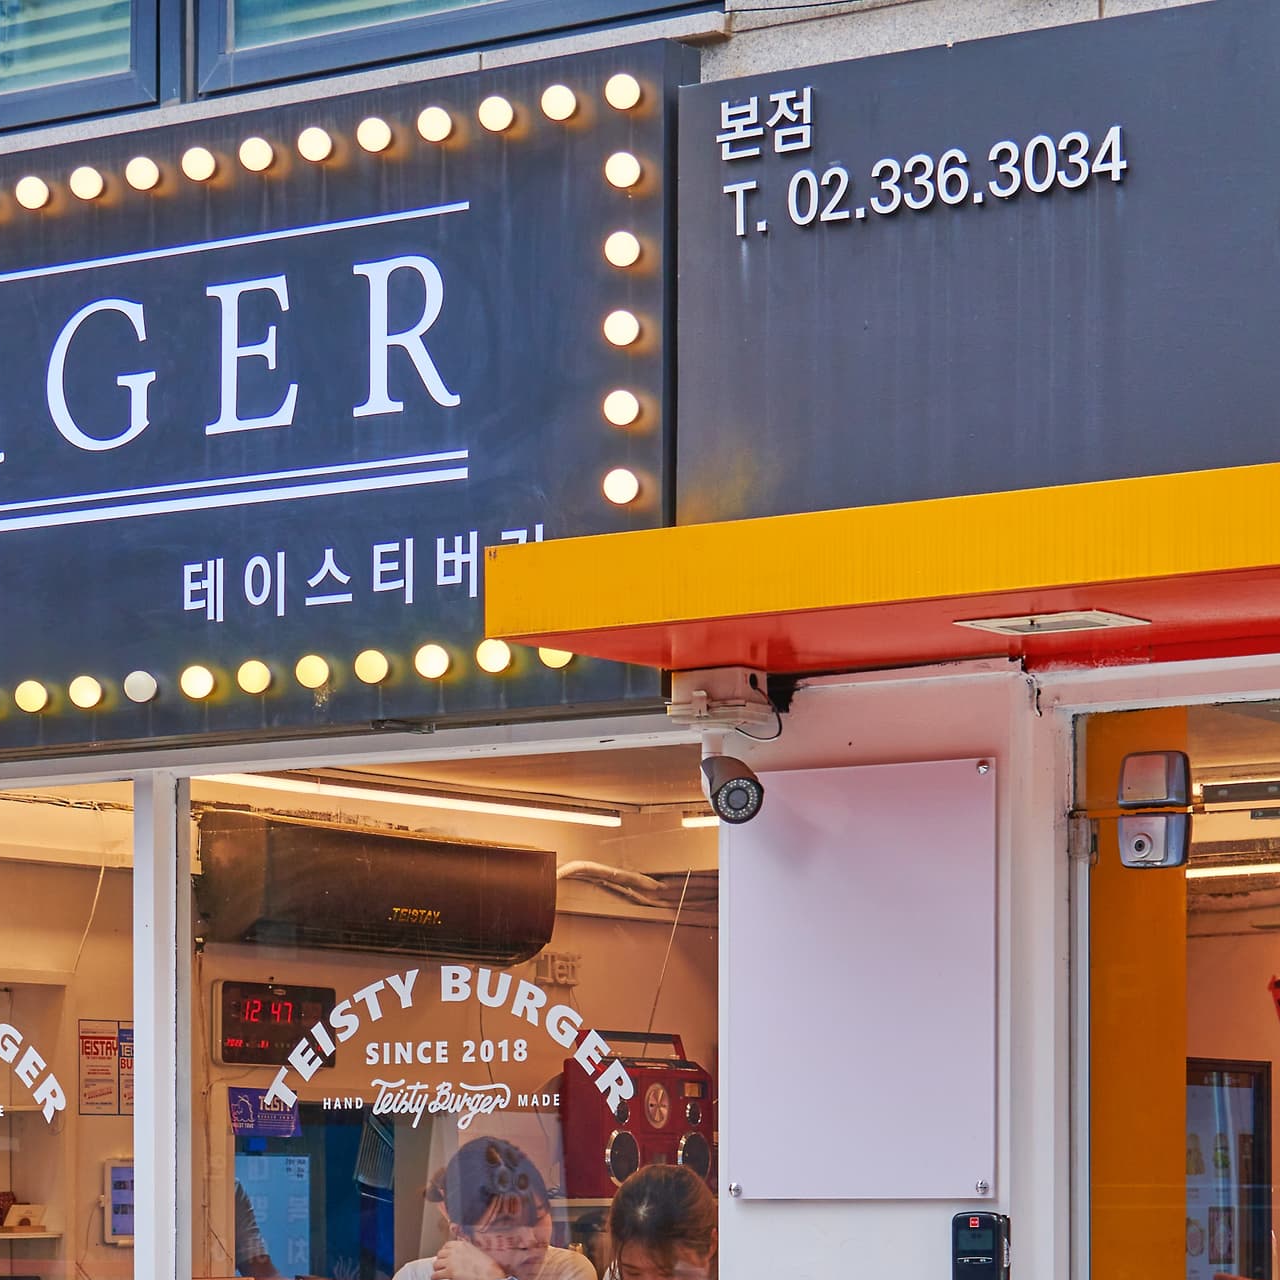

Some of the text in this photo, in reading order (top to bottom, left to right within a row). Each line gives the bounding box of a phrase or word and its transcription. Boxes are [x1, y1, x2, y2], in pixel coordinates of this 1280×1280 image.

[717, 86, 814, 161] 본점
[723, 126, 1127, 236] T. 02.336.3034
[263, 965, 636, 1115] TEISTY BURGER
[366, 1038, 529, 1065] SINCE 2018
[323, 1079, 560, 1130] HAND Teisty Burger MADE
